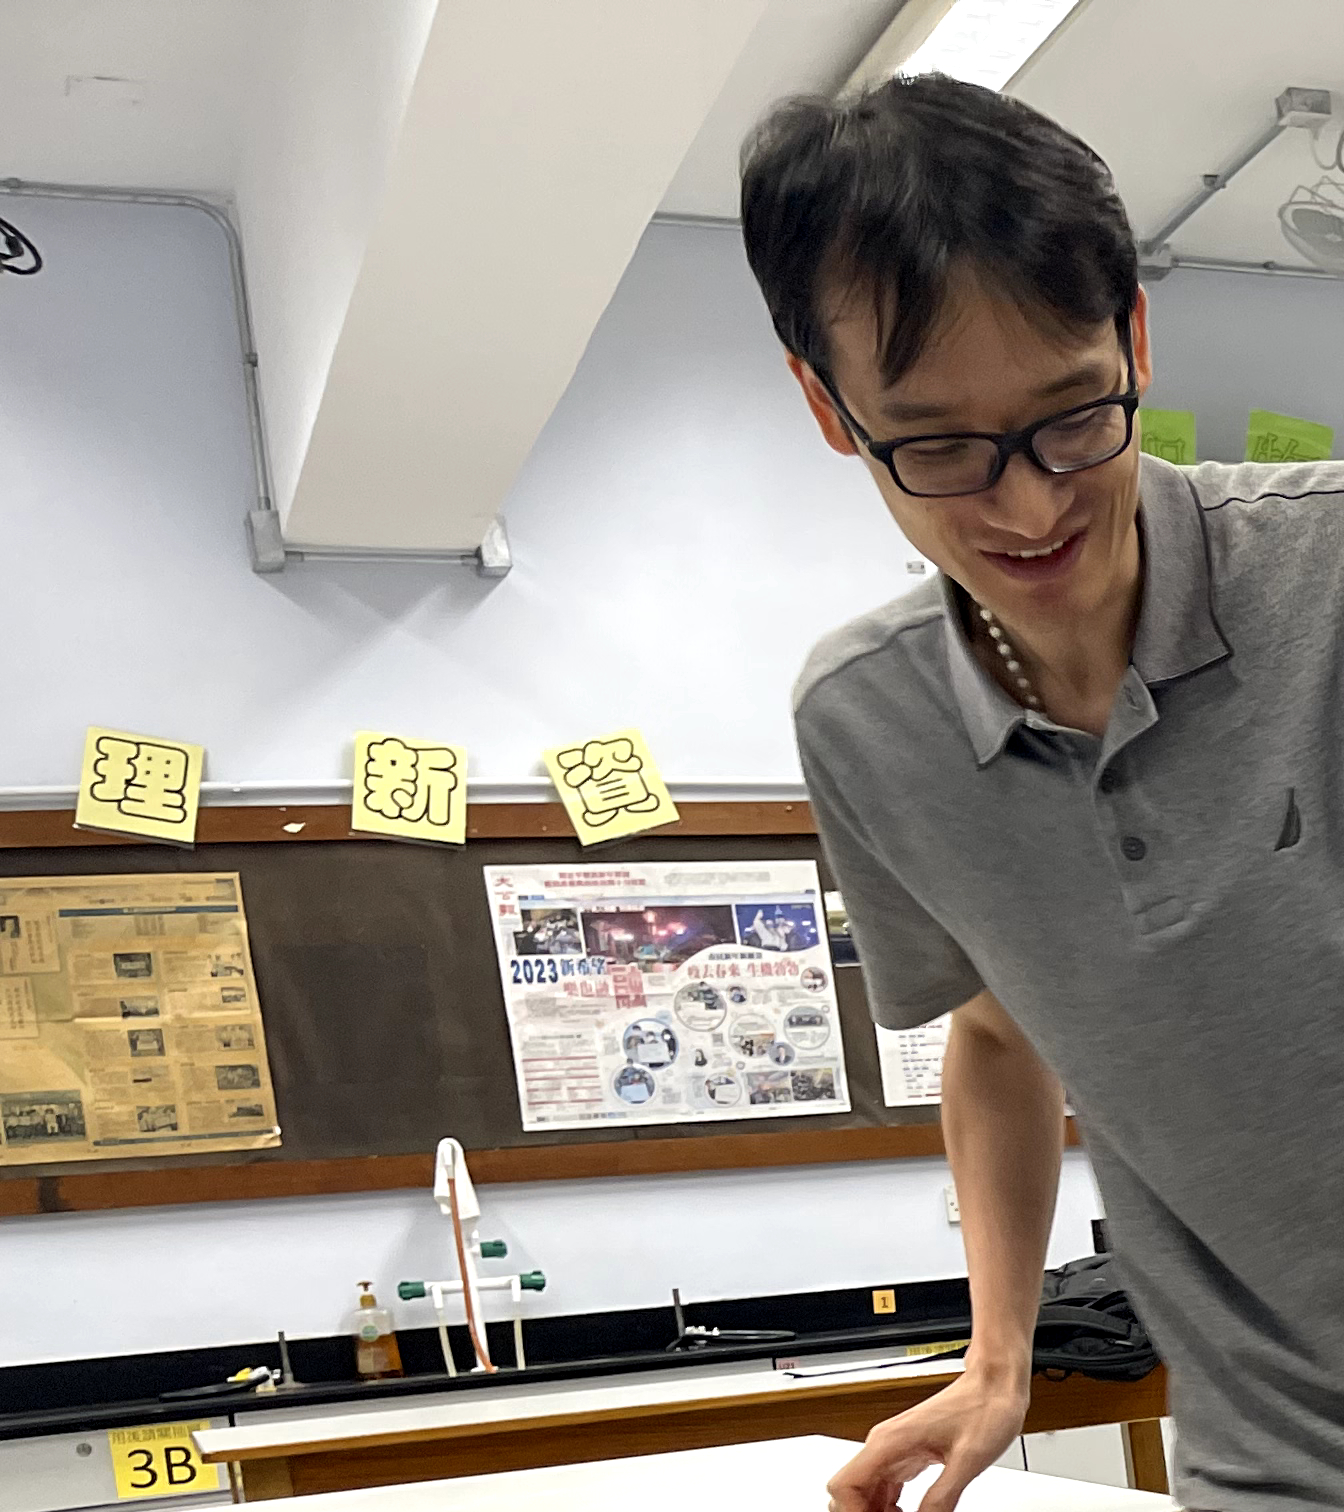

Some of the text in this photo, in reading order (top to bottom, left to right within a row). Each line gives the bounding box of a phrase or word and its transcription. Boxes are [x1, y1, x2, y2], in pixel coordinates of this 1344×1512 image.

[91, 737, 660, 826] 理 新 資
[511, 959, 559, 984] 2023
[881, 1297, 889, 1308] 1
[128, 1446, 197, 1489] 3B
